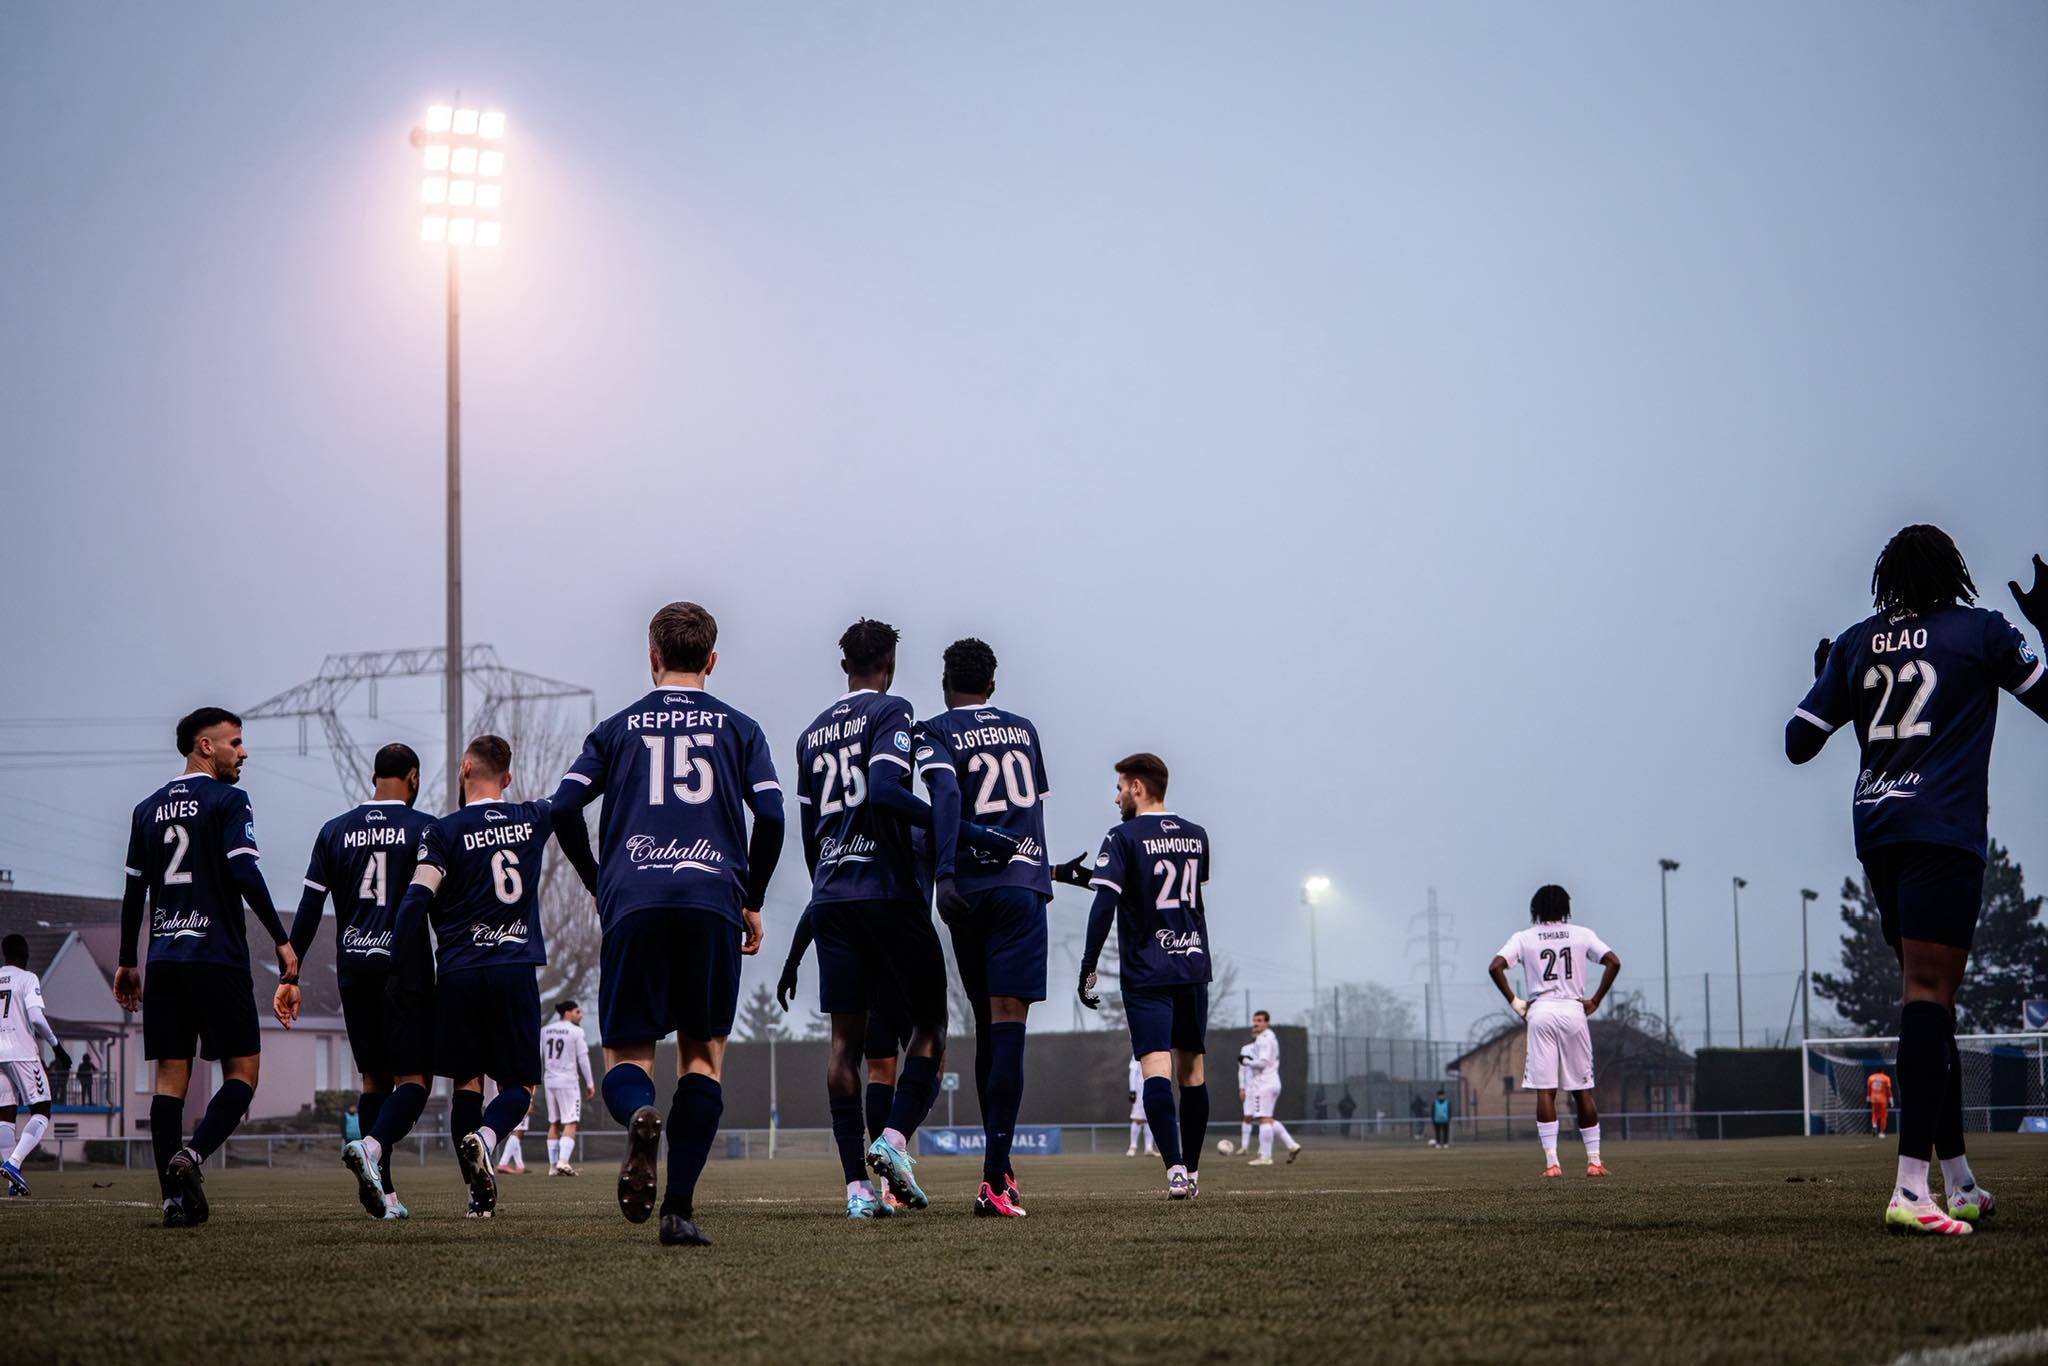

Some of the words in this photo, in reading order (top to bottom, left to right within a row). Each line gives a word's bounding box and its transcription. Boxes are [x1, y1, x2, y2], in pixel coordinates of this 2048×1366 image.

[1872, 628, 1928, 654] GLAO
[1863, 659, 1938, 743] 22
[627, 710, 728, 731] REPPERT
[807, 722, 841, 750] YATMA
[843, 714, 867, 739] DIOP
[641, 733, 715, 806] 15
[812, 742, 868, 817] 25
[968, 750, 1037, 816] 20
[155, 800, 199, 823] ALVES
[344, 827, 406, 848] MBIMBA
[463, 822, 534, 851] DECHERF
[627, 834, 725, 863] Caballin
[1142, 838, 1203, 855] TAHMOUCH
[163, 824, 193, 886] 2
[359, 851, 387, 907] 4
[491, 849, 524, 905] 6
[1153, 858, 1199, 911] 24
[343, 924, 393, 947] Caballi
[1540, 946, 1573, 981] 21
[547, 1038, 565, 1060] 19
[1038, 1133, 1048, 1148] 2
